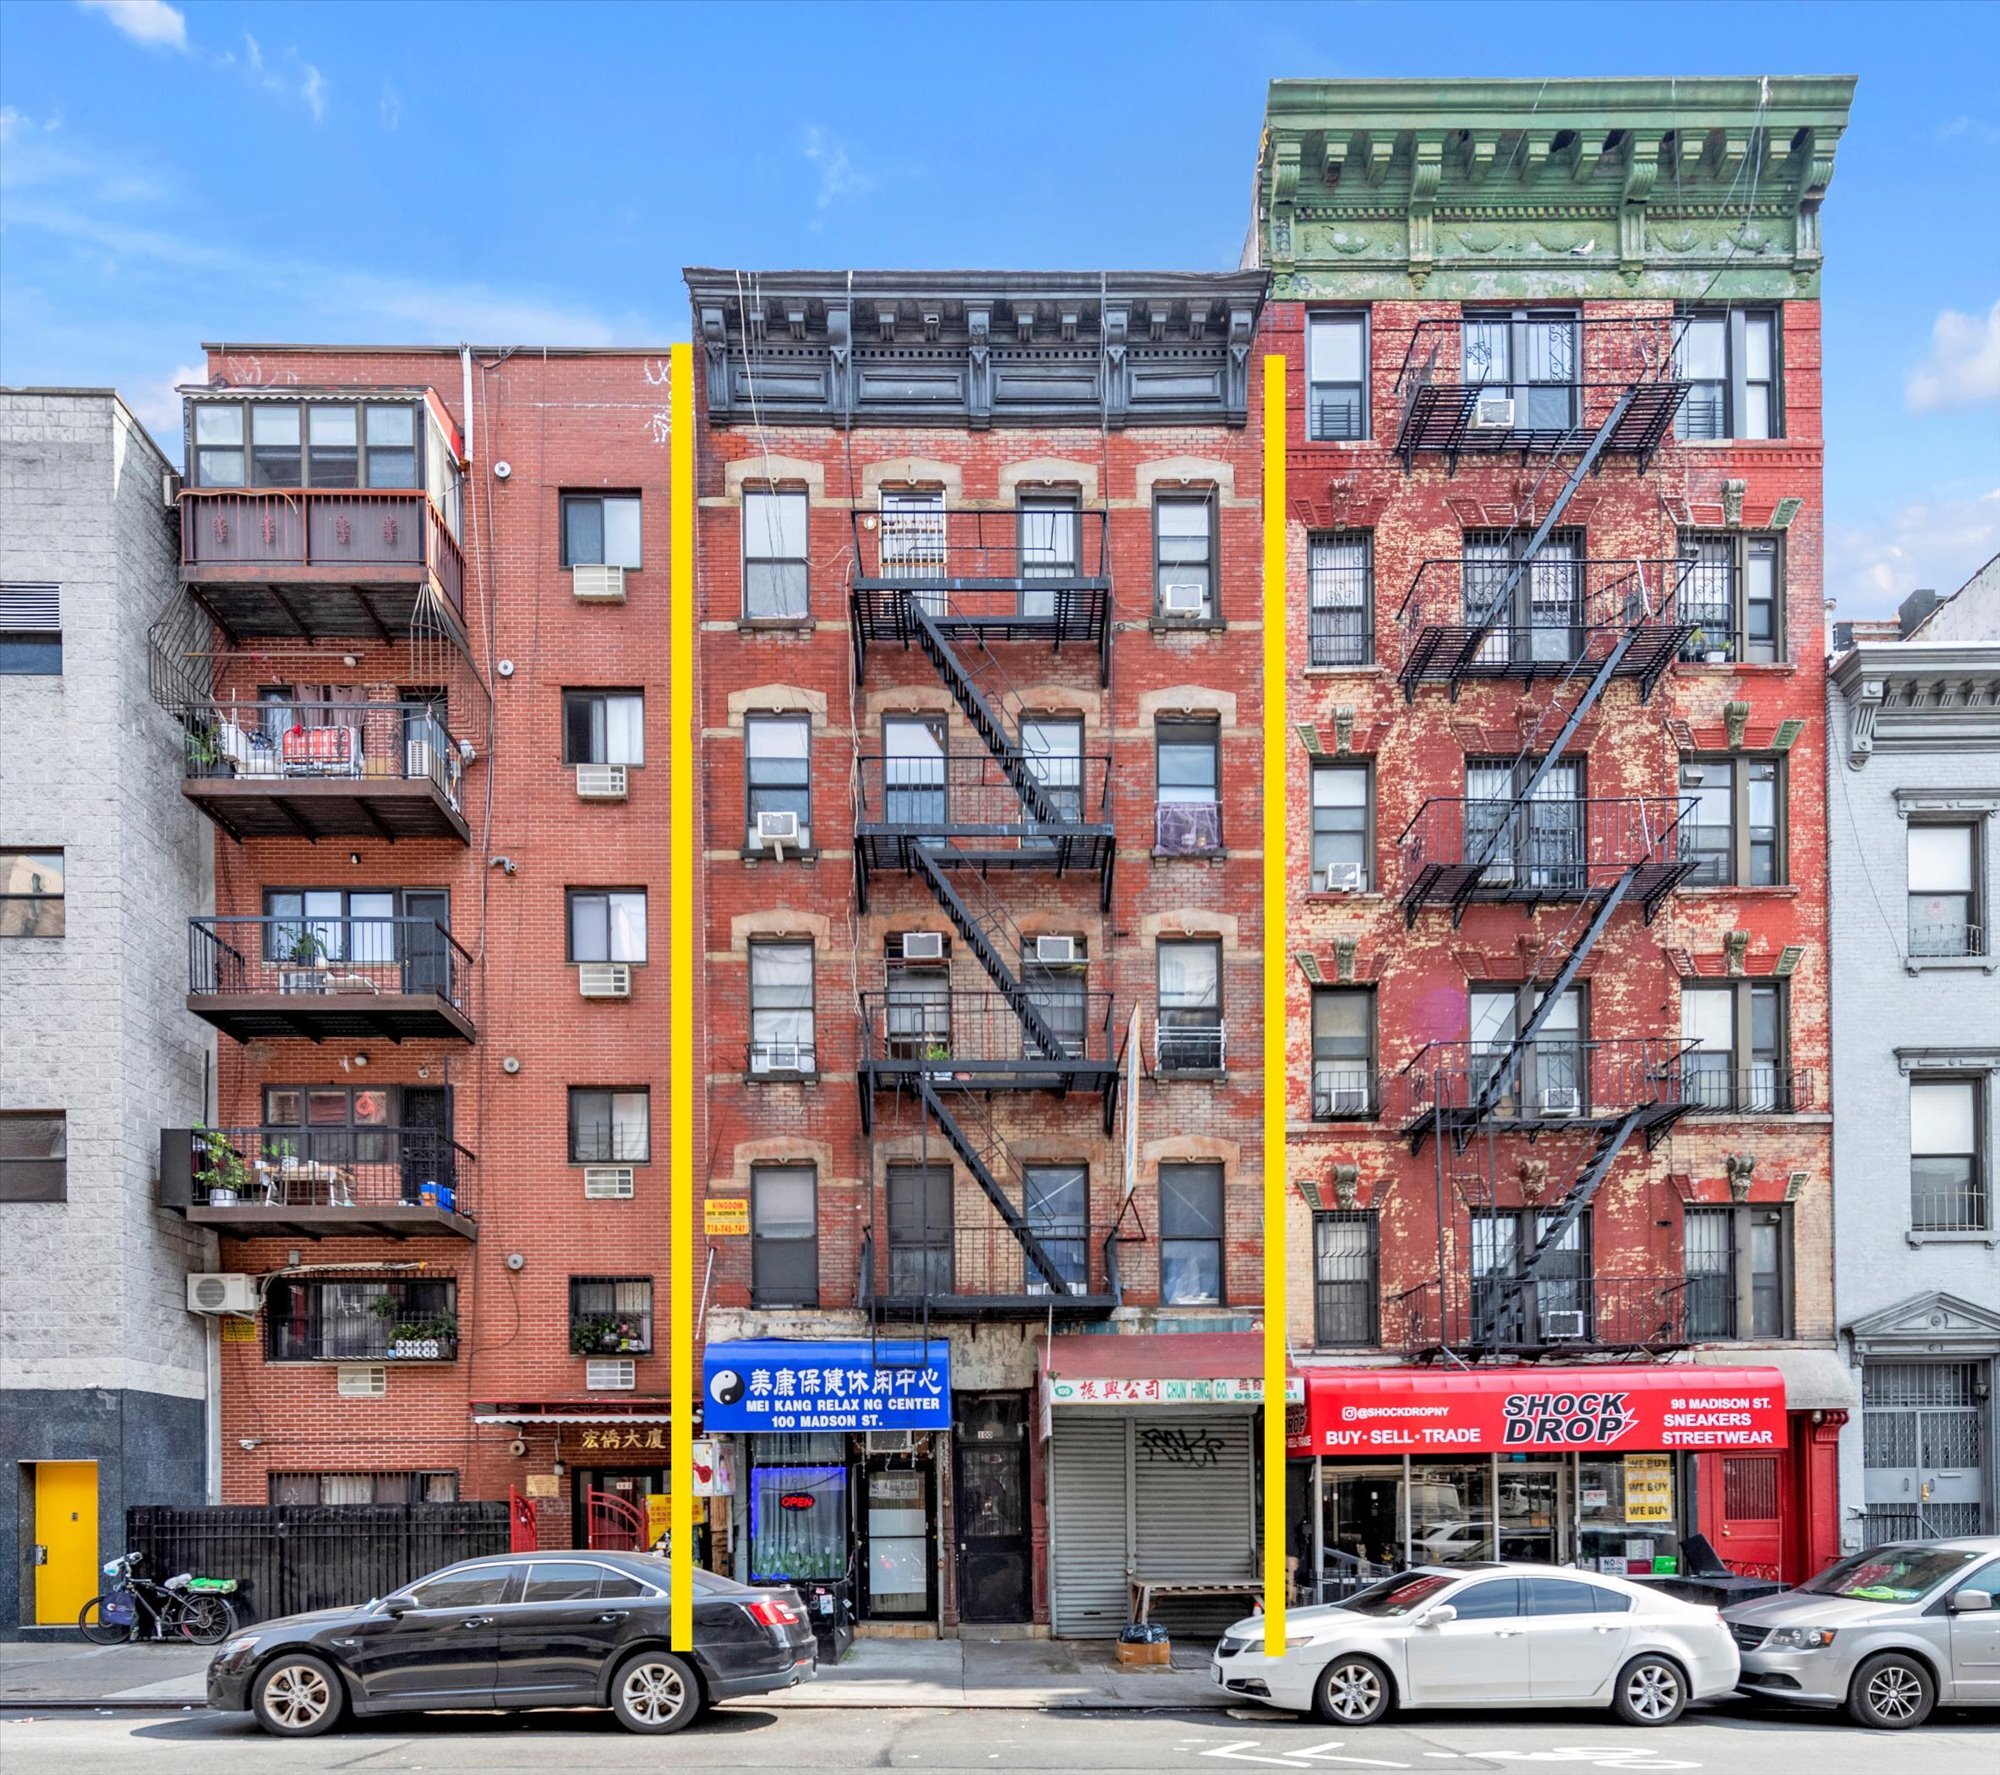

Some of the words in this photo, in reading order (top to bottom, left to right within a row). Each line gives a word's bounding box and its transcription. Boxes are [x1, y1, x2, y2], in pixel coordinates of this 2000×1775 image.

[749, 1367, 942, 1397] 美康保健休闲中心
[1167, 1382, 1186, 1398] CHUN
[746, 1400, 769, 1412] MEI
[774, 1400, 812, 1412] KANG
[887, 1397, 940, 1410] CENTER
[1503, 1393, 1629, 1418] SHOCK
[1671, 1399, 1686, 1409] 98
[1689, 1398, 1749, 1409] MADISON
[1752, 1397, 1772, 1408] ST.
[1357, 1407, 1449, 1419] @SHOCKDROPNY
[1663, 1413, 1752, 1427] SNEAKERS
[772, 1416, 795, 1427] 100
[800, 1415, 856, 1427] MADSON
[861, 1414, 883, 1427] ST.
[1325, 1430, 1362, 1445] BUY
[1370, 1429, 1414, 1443] SELL
[1422, 1428, 1481, 1442] TRADE
[1503, 1415, 1625, 1444] DROP
[1662, 1430, 1773, 1444] STREETWEAR
[1628, 1460, 1645, 1468] WE
[1647, 1460, 1668, 1468] BUY
[1629, 1484, 1645, 1492] WE
[1648, 1483, 1668, 1491] BUY
[781, 1497, 812, 1507] OPEN
[1630, 1507, 1646, 1515] WE
[1648, 1506, 1669, 1515] BUY
